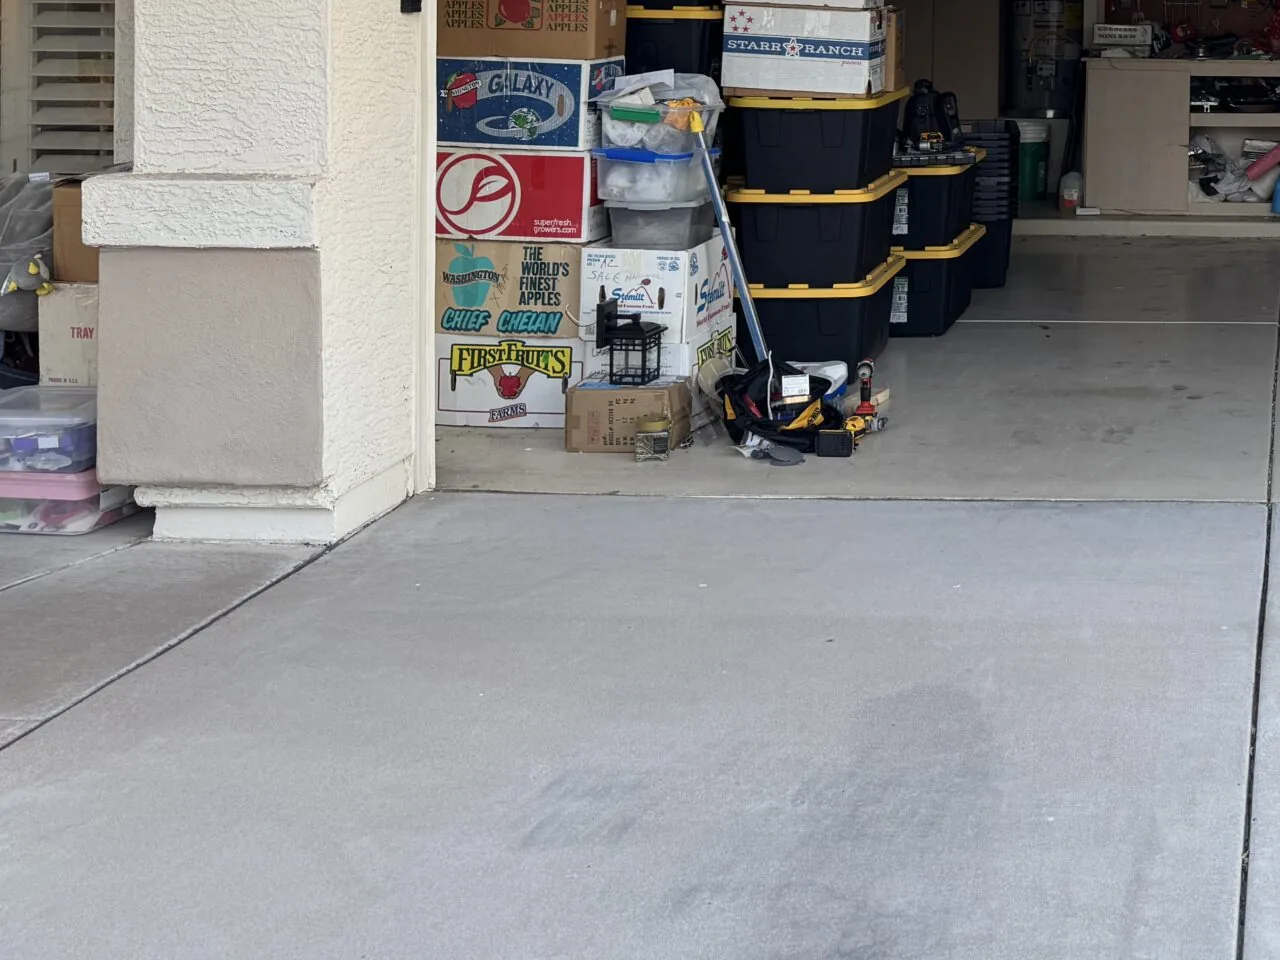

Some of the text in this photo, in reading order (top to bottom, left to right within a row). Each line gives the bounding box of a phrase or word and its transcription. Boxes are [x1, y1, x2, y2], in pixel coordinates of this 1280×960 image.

[443, 0, 485, 10] APPLES
[547, 4, 589, 13] APPLES
[443, 10, 485, 19] APPLES
[546, 13, 588, 22] APPLES
[443, 19, 484, 29] APPLES
[546, 22, 588, 32] APPLES
[727, 40, 782, 51] STARR
[804, 44, 863, 56] RANCH
[533, 226, 577, 235] growers.com
[523, 246, 544, 261] THE
[521, 261, 570, 277] WORLD'S
[442, 270, 499, 284] WASHINGTON
[519, 277, 558, 291] FINEST
[519, 292, 561, 306] APPLES
[440, 307, 563, 335] CHIEF CHELAN
[70, 326, 94, 339] TRAY
[490, 403, 526, 421] FARMS
